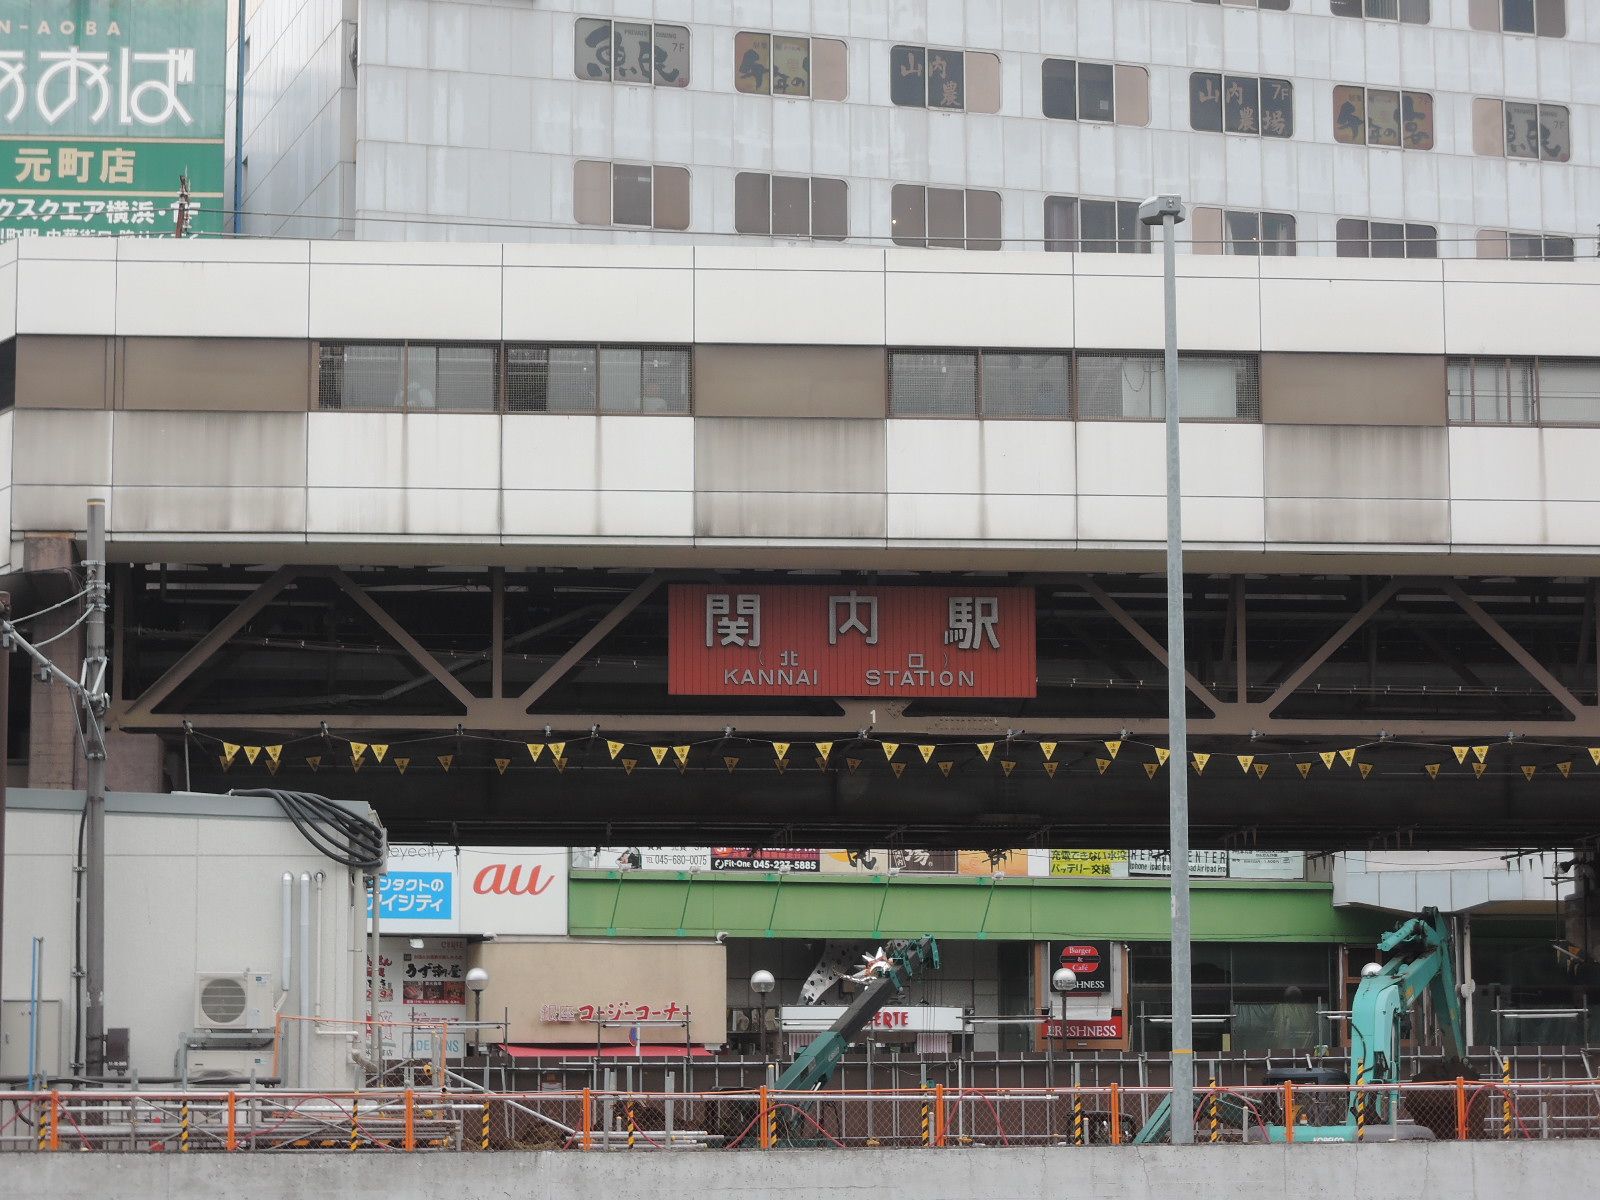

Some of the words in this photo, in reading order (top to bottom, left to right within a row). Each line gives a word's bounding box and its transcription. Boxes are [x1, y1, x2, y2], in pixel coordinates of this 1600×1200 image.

[1271, 83, 1288, 100] 7F
[15, 148, 136, 184] 元町店
[723, 669, 819, 686] KANNAI
[865, 670, 975, 687] STATION
[724, 859, 751, 868] Fit-One
[1051, 863, 1111, 875] バッテリー交換
[473, 864, 555, 896] au
[1069, 947, 1091, 955] Burger
